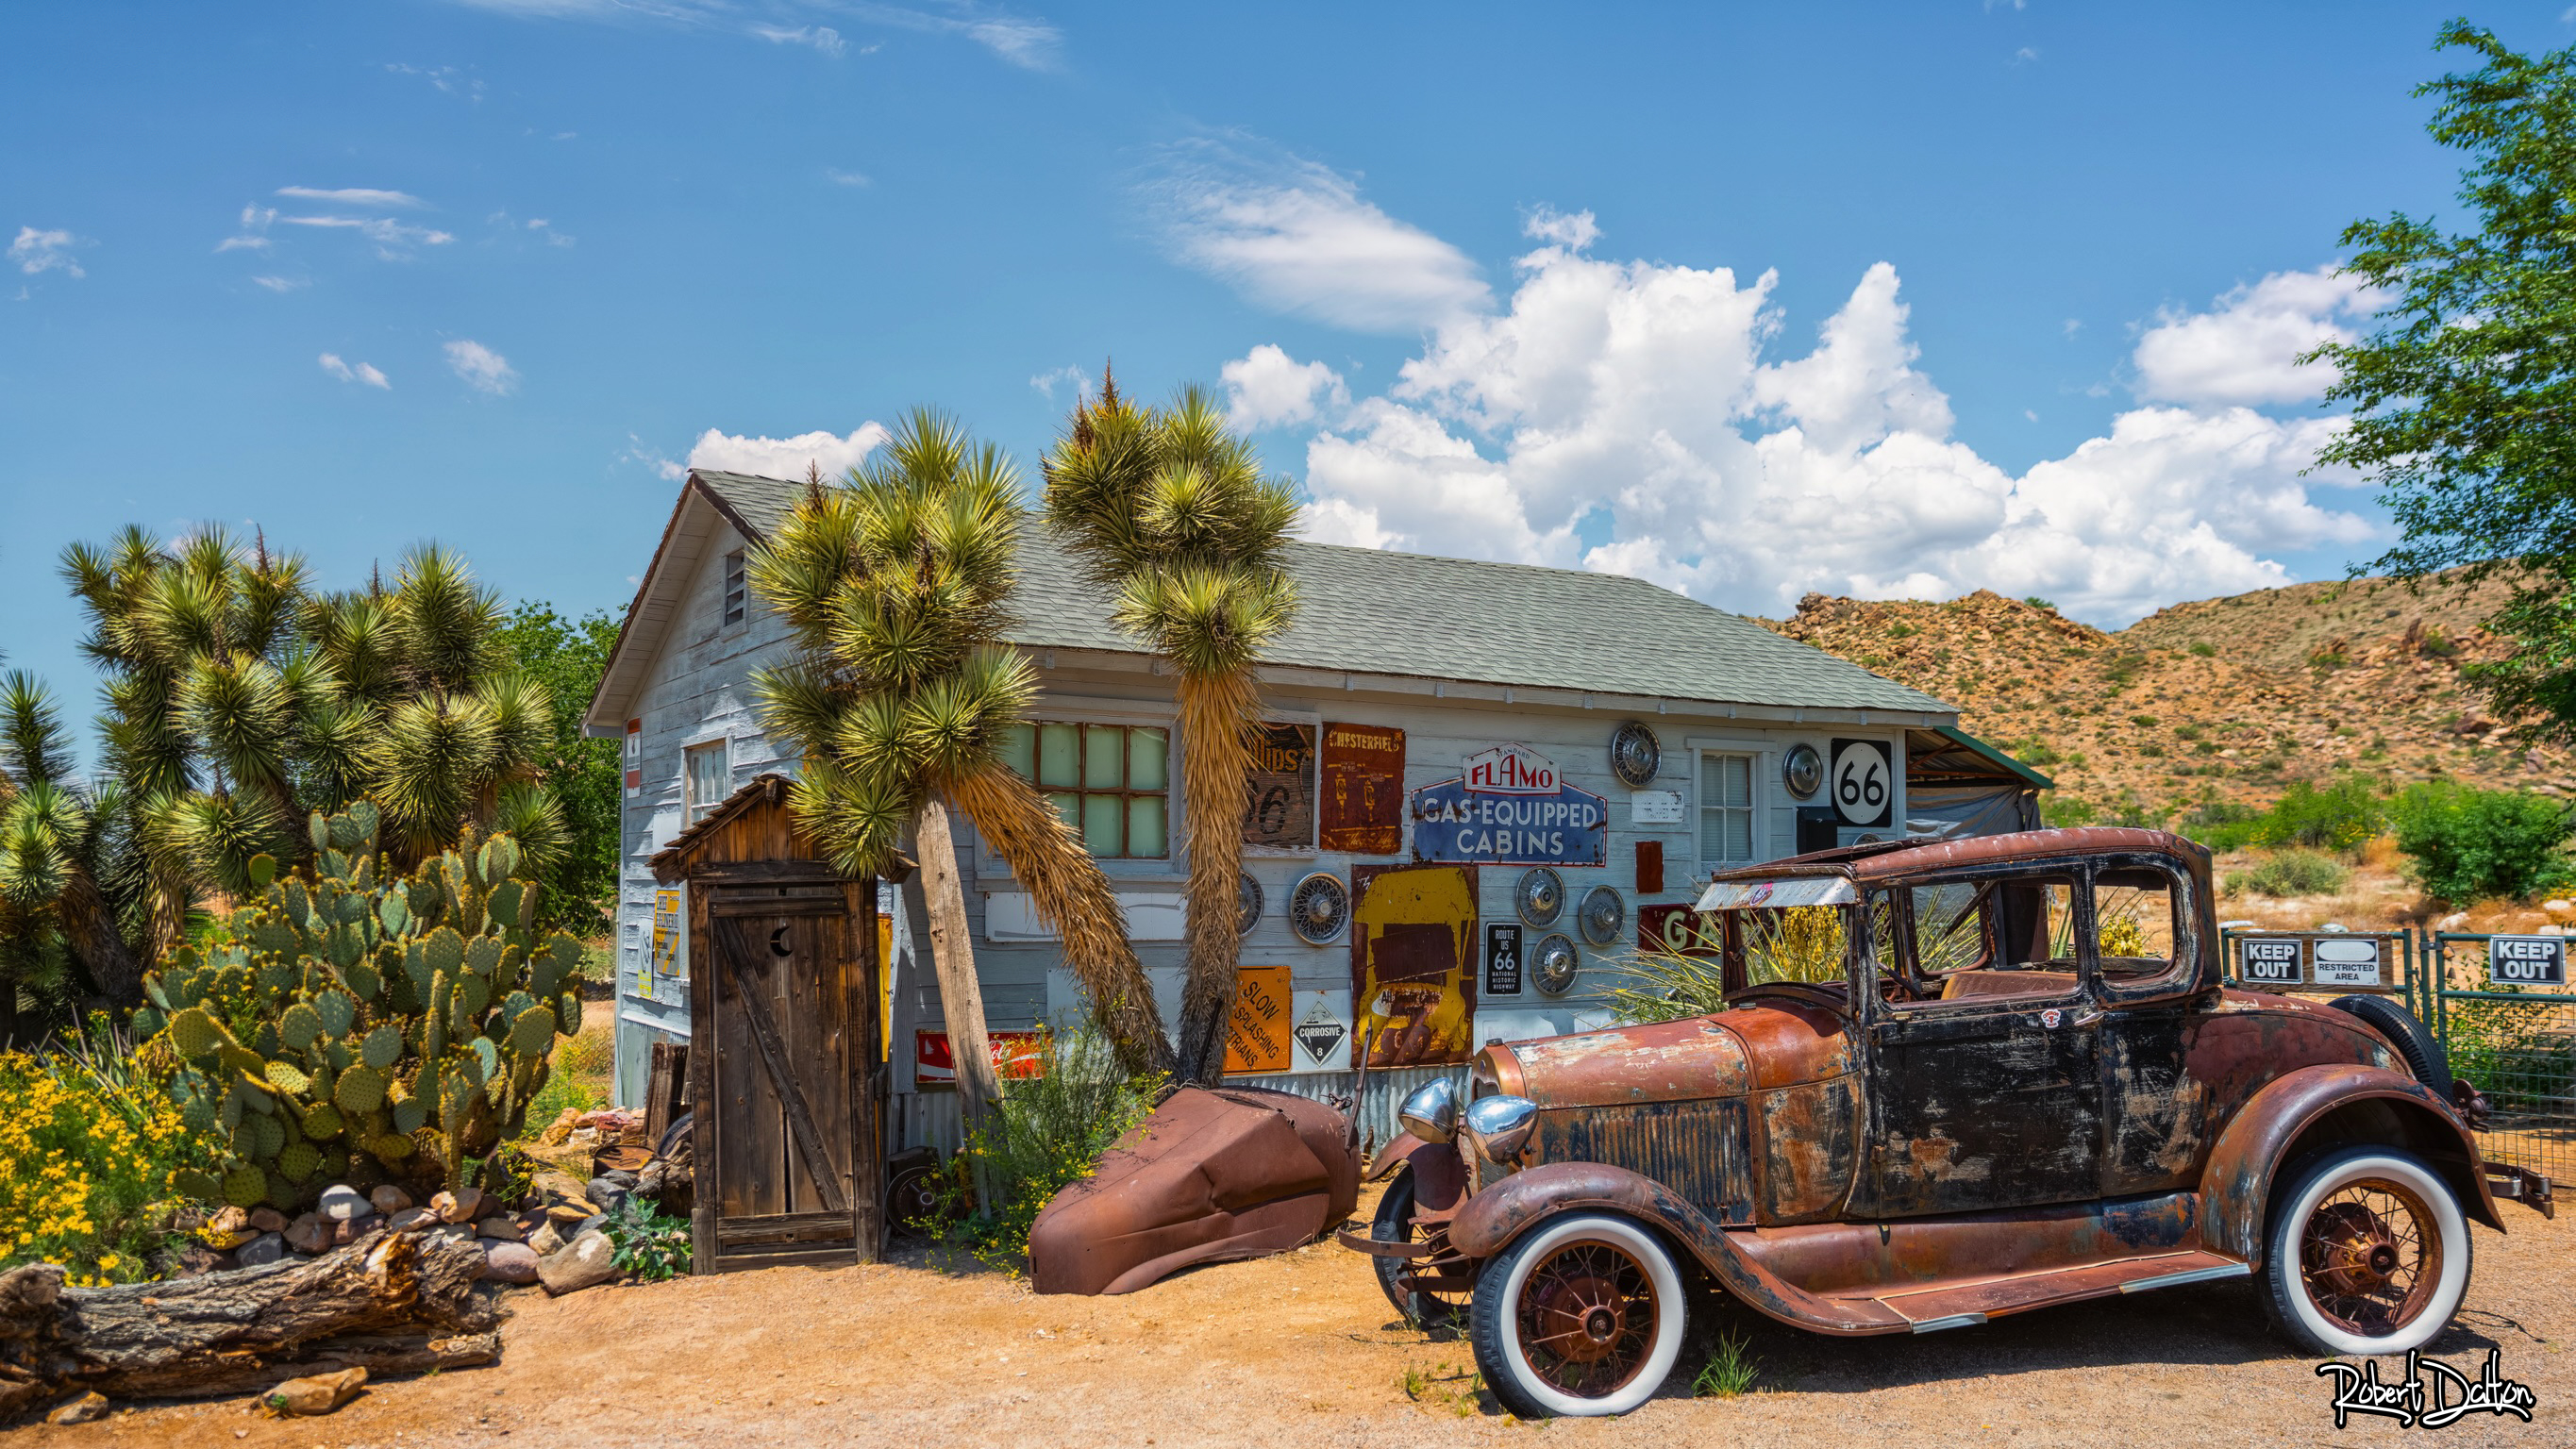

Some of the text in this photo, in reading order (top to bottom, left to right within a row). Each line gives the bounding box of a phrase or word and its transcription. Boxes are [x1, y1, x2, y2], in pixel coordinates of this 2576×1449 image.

[1496, 748, 1531, 759] STANDARD
[1471, 754, 1553, 789] FLAMO
[1839, 759, 1884, 807] 66
[1424, 797, 1597, 827] GAS-EQUIPPED
[1456, 829, 1564, 856] CABINS
[1495, 929, 1514, 940] ROUTE
[1500, 941, 1510, 951] US
[2248, 943, 2296, 960] KEEP
[2498, 941, 2557, 960] KEEP
[1494, 951, 1515, 971] 66
[2254, 960, 2291, 978] OUT
[2318, 963, 2375, 972] RESTRICTED
[2504, 960, 2551, 979] OUT
[2334, 973, 2360, 981] AREA
[1244, 981, 1280, 1021] SLOW
[1234, 1007, 1280, 1059] SPLASHING
[1299, 1026, 1341, 1038] CORROSIVE
[1316, 1047, 1324, 1057] 8
